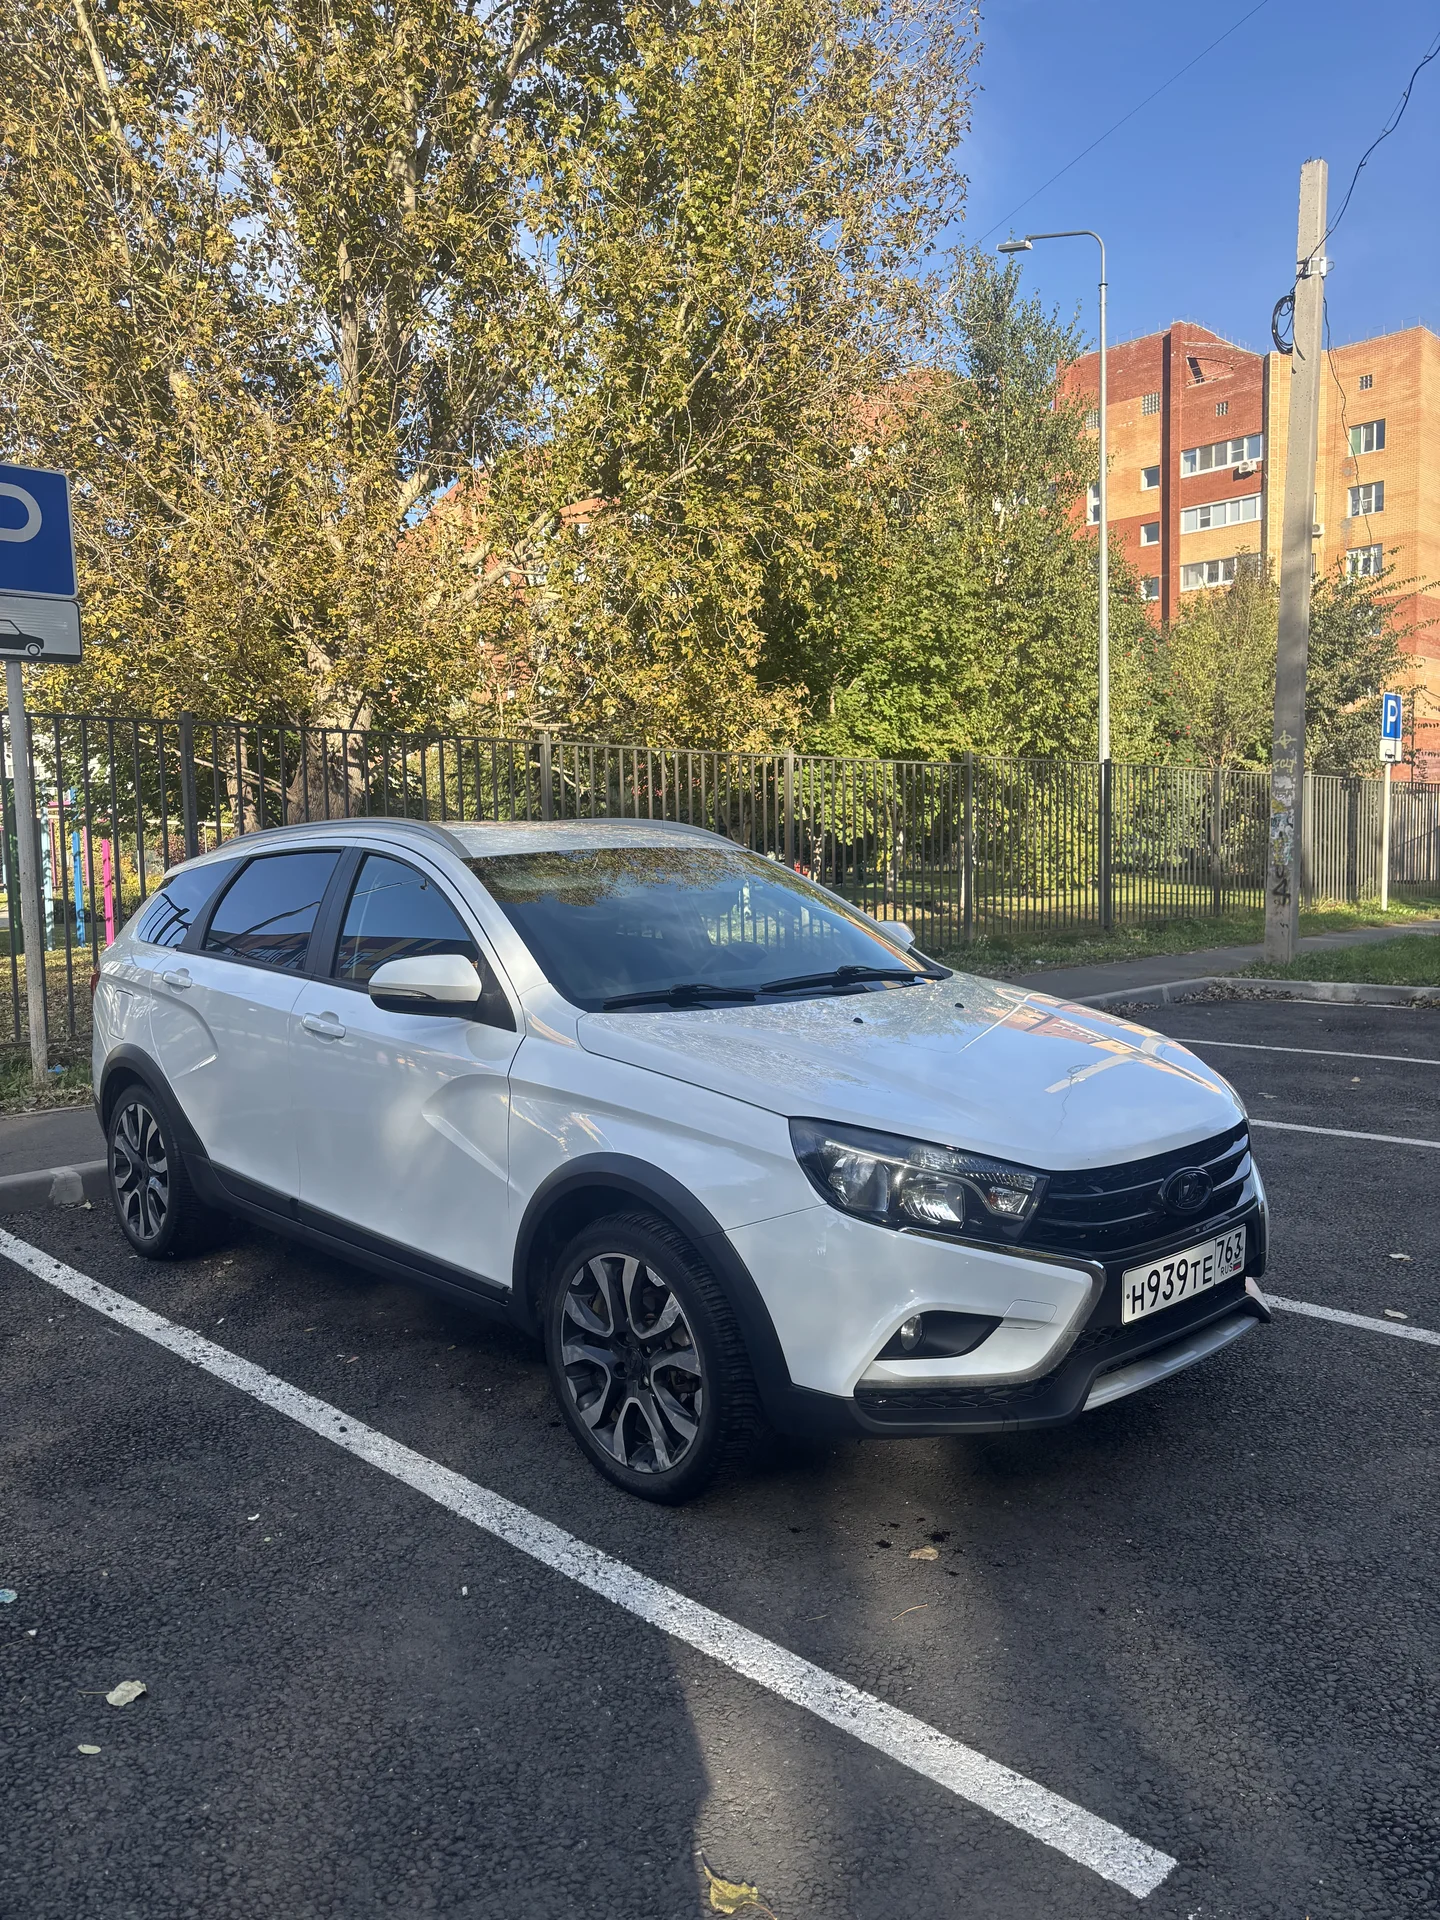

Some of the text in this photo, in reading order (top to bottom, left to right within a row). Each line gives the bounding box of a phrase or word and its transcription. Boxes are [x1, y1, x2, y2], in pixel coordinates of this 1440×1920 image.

[1387, 700, 1398, 733] P
[1217, 1232, 1242, 1268] 763
[1220, 1262, 1233, 1276] RUS
